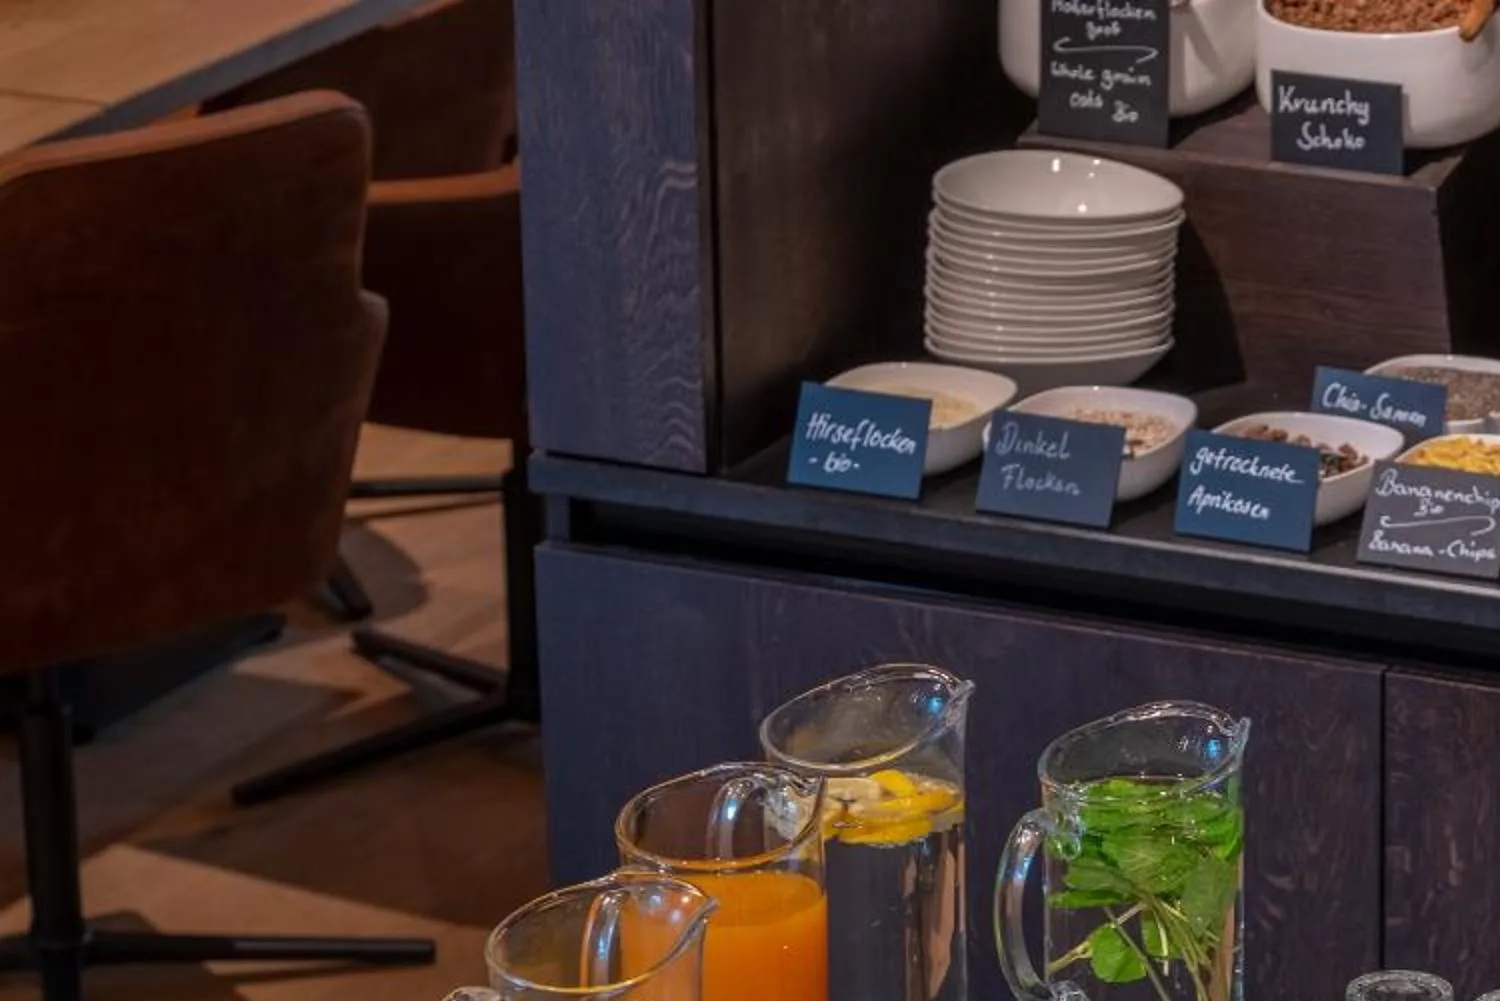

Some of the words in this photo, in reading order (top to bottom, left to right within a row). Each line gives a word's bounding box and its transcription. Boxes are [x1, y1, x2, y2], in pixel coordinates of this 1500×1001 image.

[1101, 66, 1151, 90] grain
[1278, 85, 1370, 126] Krunchy
[1296, 120, 1366, 151] Schoko
[805, 411, 917, 455] Hirseflocken
[995, 421, 1071, 459] Dinkel
[1000, 463, 1081, 496] Flocken
[1413, 498, 1444, 517] Bio
